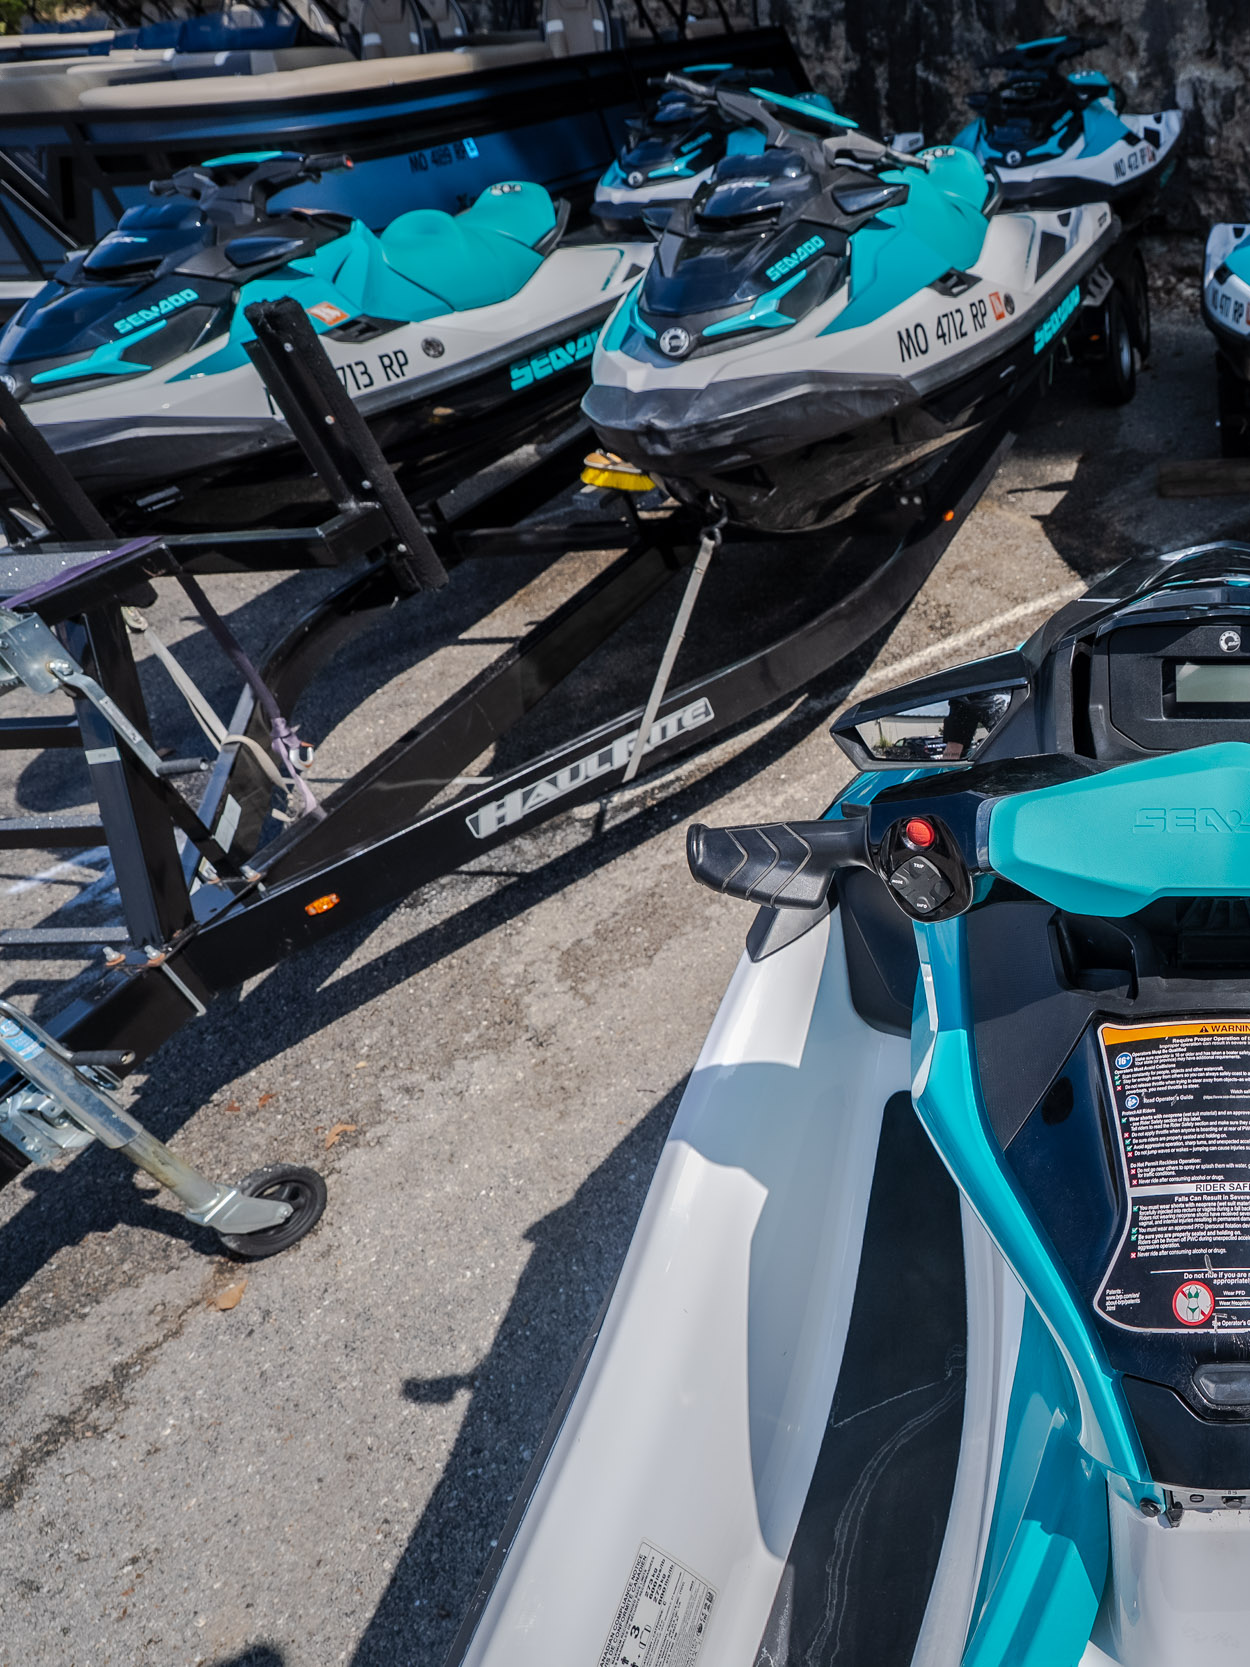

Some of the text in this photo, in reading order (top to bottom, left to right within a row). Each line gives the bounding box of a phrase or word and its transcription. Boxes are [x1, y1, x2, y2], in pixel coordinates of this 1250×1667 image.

[897, 299, 987, 363] MO 4712 RP
[378, 349, 409, 382] RP
[1195, 1183, 1226, 1192] RIDER
[631, 1555, 647, 1593] CANADIEN
[645, 1567, 658, 1598] 273 kg
[653, 1573, 667, 1604] 273 kg
[613, 1582, 633, 1631] COMPLIANCE
[631, 1554, 643, 1580] NOTICE
[648, 1581, 658, 1600] 600
[630, 1625, 640, 1640] 3
